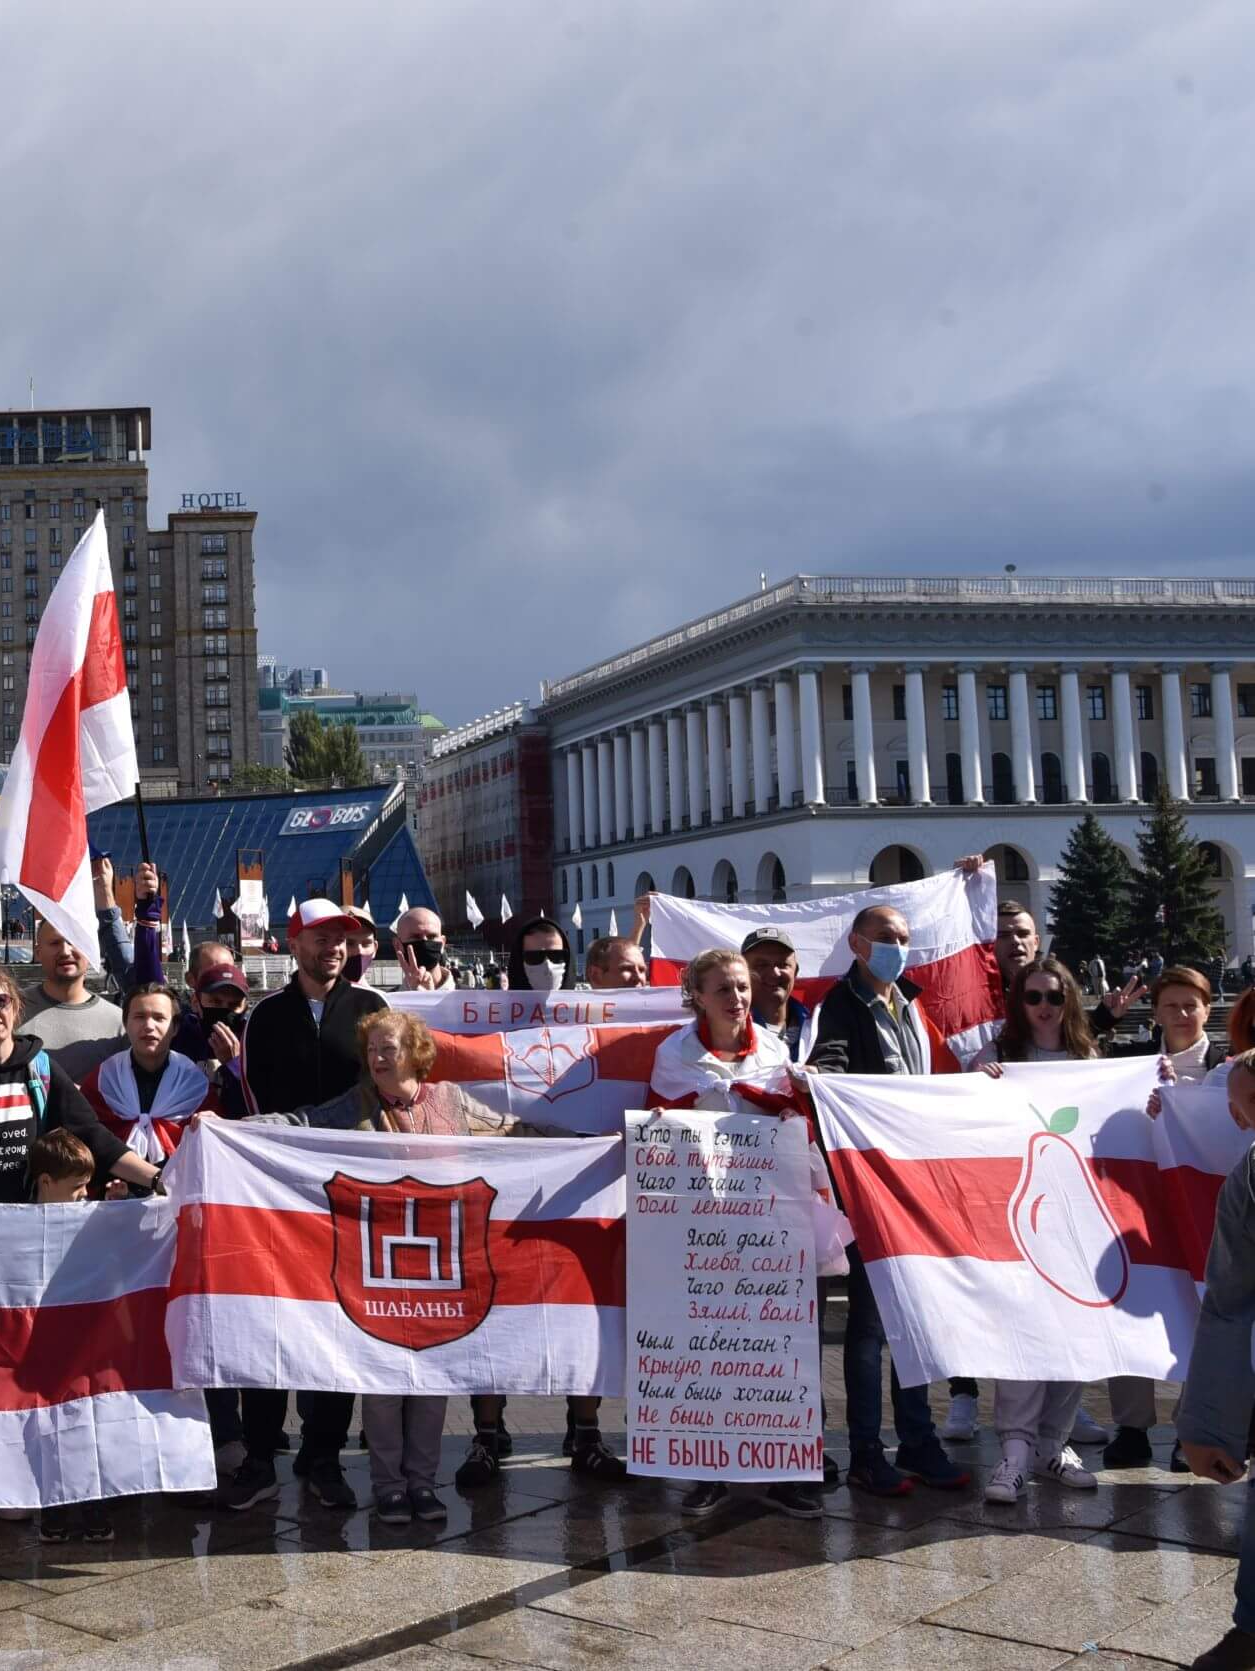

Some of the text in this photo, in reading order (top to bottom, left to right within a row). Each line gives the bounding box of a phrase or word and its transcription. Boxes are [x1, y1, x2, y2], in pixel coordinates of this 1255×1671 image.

[181, 492, 247, 508] HOTEL
[290, 805, 370, 829] GLOBUS
[463, 1001, 616, 1025] БЕРАСЦЕ
[635, 1124, 671, 1144] Хто
[680, 1129, 703, 1144] ты
[636, 1172, 676, 1191] Чаго
[635, 1194, 775, 1217] Долі лепшай!
[687, 1228, 789, 1254] Якой долі?
[751, 1249, 806, 1273] солі!
[687, 1277, 804, 1298] Чаго болей?
[364, 1300, 465, 1318] ШАБАНЫ
[636, 1330, 675, 1350] Чым
[638, 1380, 677, 1399] Чым
[684, 1382, 722, 1401] быць
[637, 1403, 813, 1430] Не быць скотам!
[632, 1436, 823, 1471] НЕ БЫЦЬ СКОТАМ!
